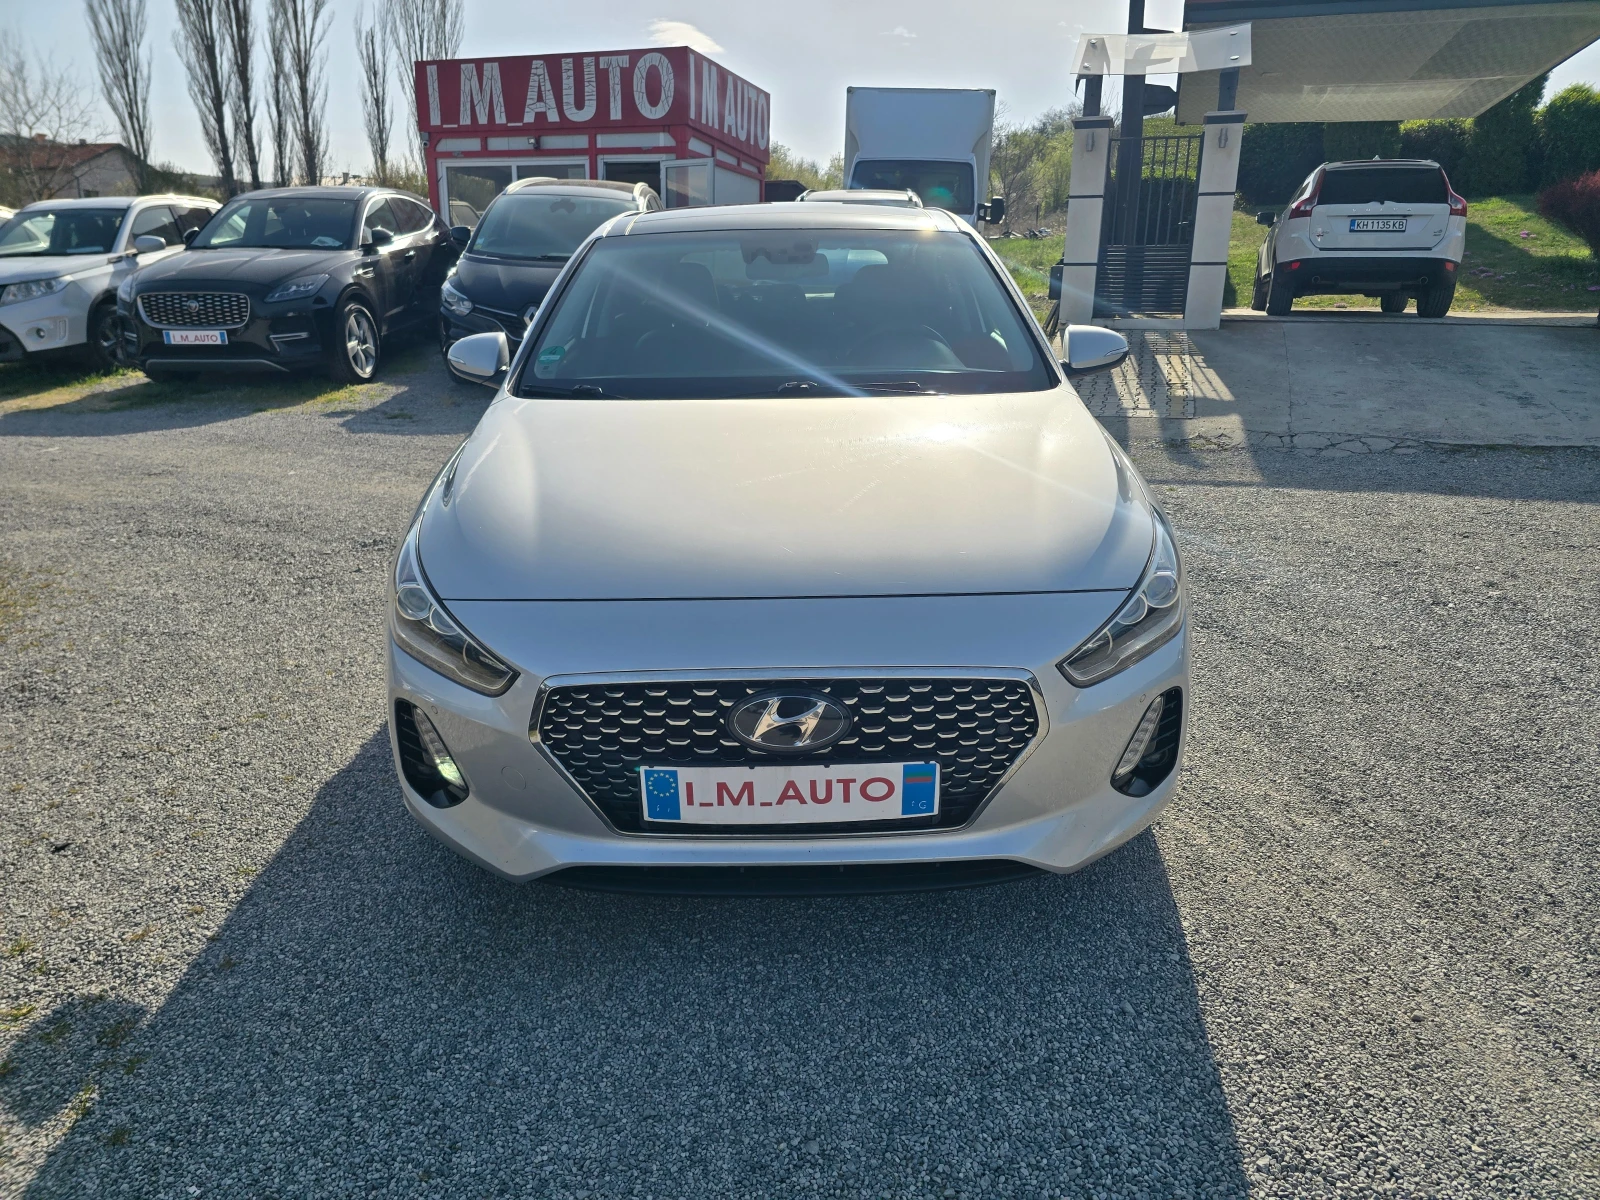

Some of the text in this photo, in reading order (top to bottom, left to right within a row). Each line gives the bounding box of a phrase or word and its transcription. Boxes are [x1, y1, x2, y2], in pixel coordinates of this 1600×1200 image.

[701, 60, 719, 130] M
[723, 74, 768, 150] AUTO
[685, 776, 896, 807] I_M_AUTO
